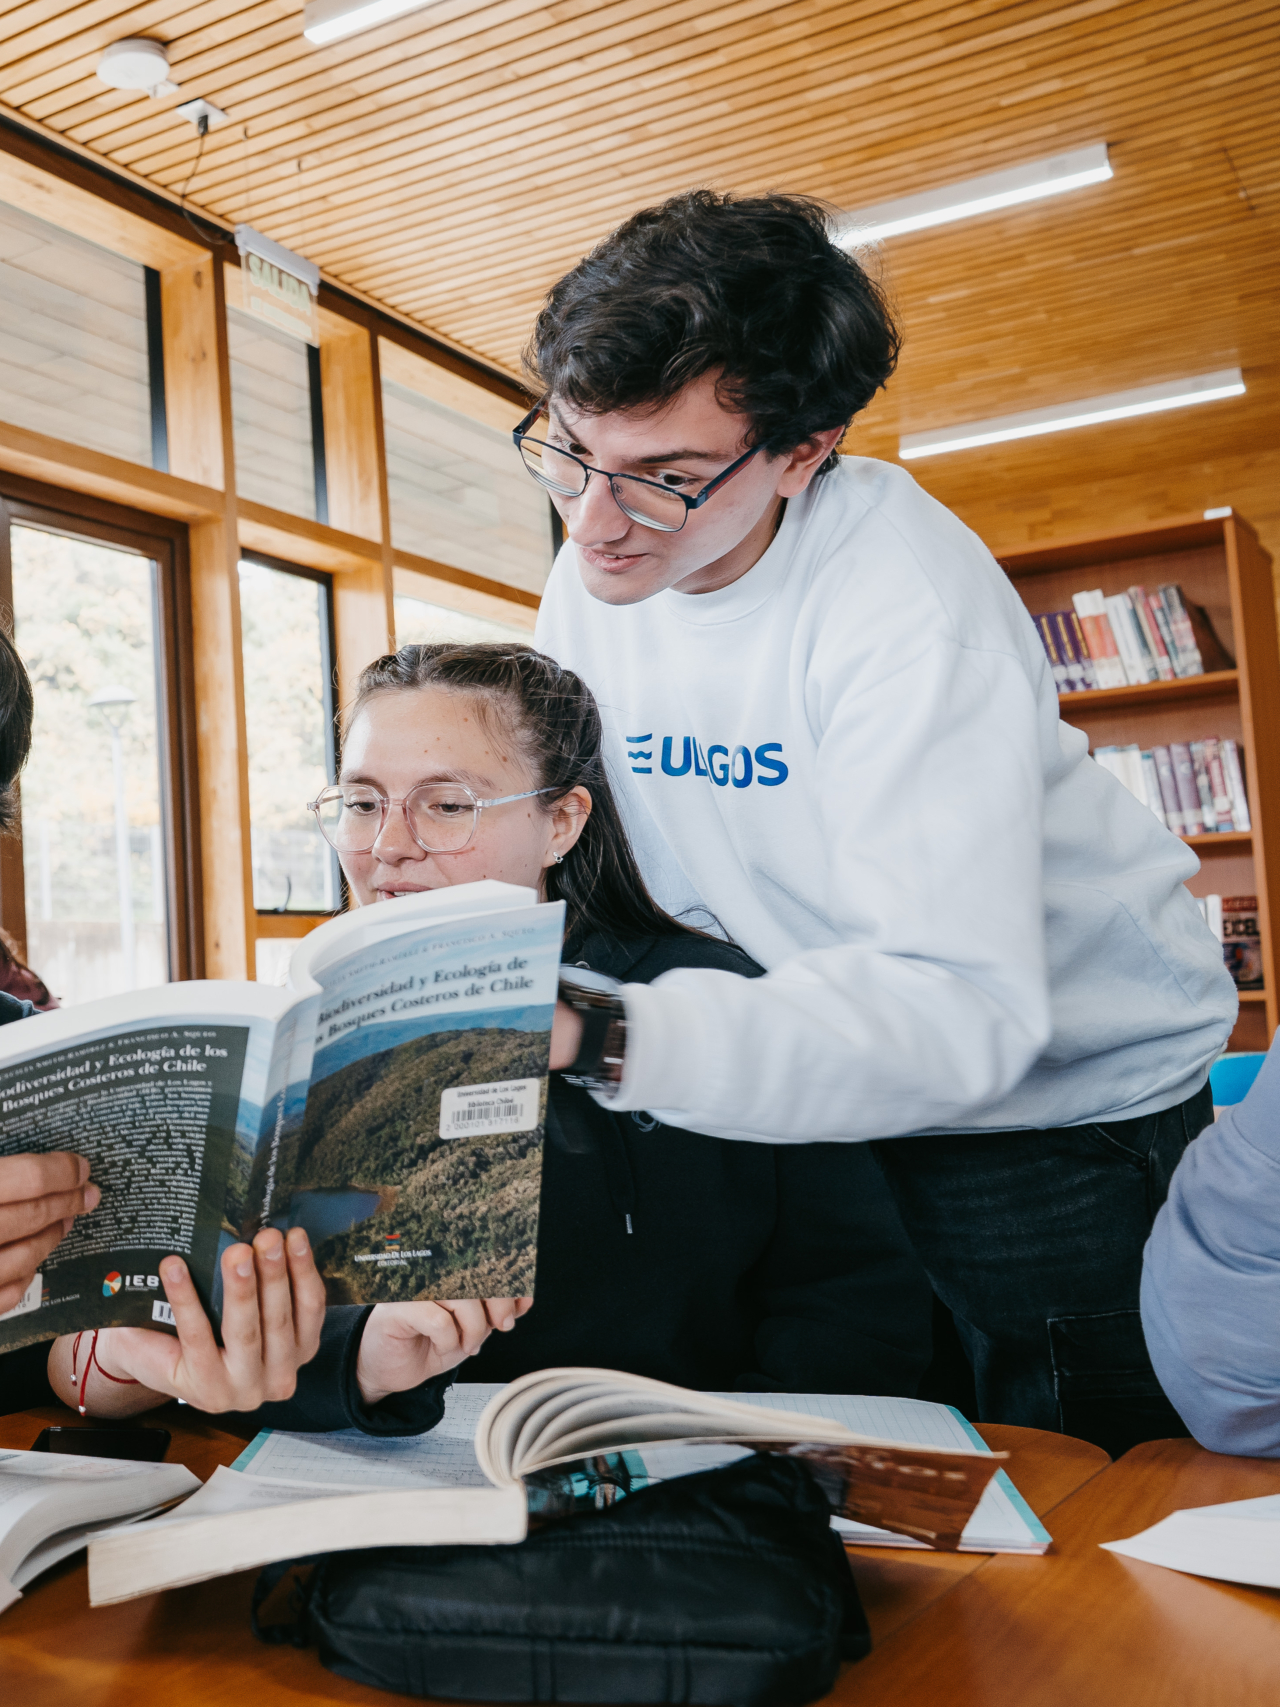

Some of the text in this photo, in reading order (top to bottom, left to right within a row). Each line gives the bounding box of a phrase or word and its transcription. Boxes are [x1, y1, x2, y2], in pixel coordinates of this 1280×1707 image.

[661, 736, 789, 789] ULGOS
[419, 977, 429, 992] y
[434, 959, 502, 983] Ecología
[507, 956, 528, 971] de
[328, 1006, 386, 1038] Bosques
[391, 987, 460, 1013] Costeros
[464, 982, 486, 997] de
[490, 975, 535, 993] Chile
[94, 1060, 104, 1075] y
[109, 1045, 176, 1067] Ecología
[179, 1044, 202, 1058] de
[205, 1044, 229, 1058] los
[2, 1059, 208, 1113] Bosques Costeros de Chile
[125, 1274, 160, 1288] IEB
